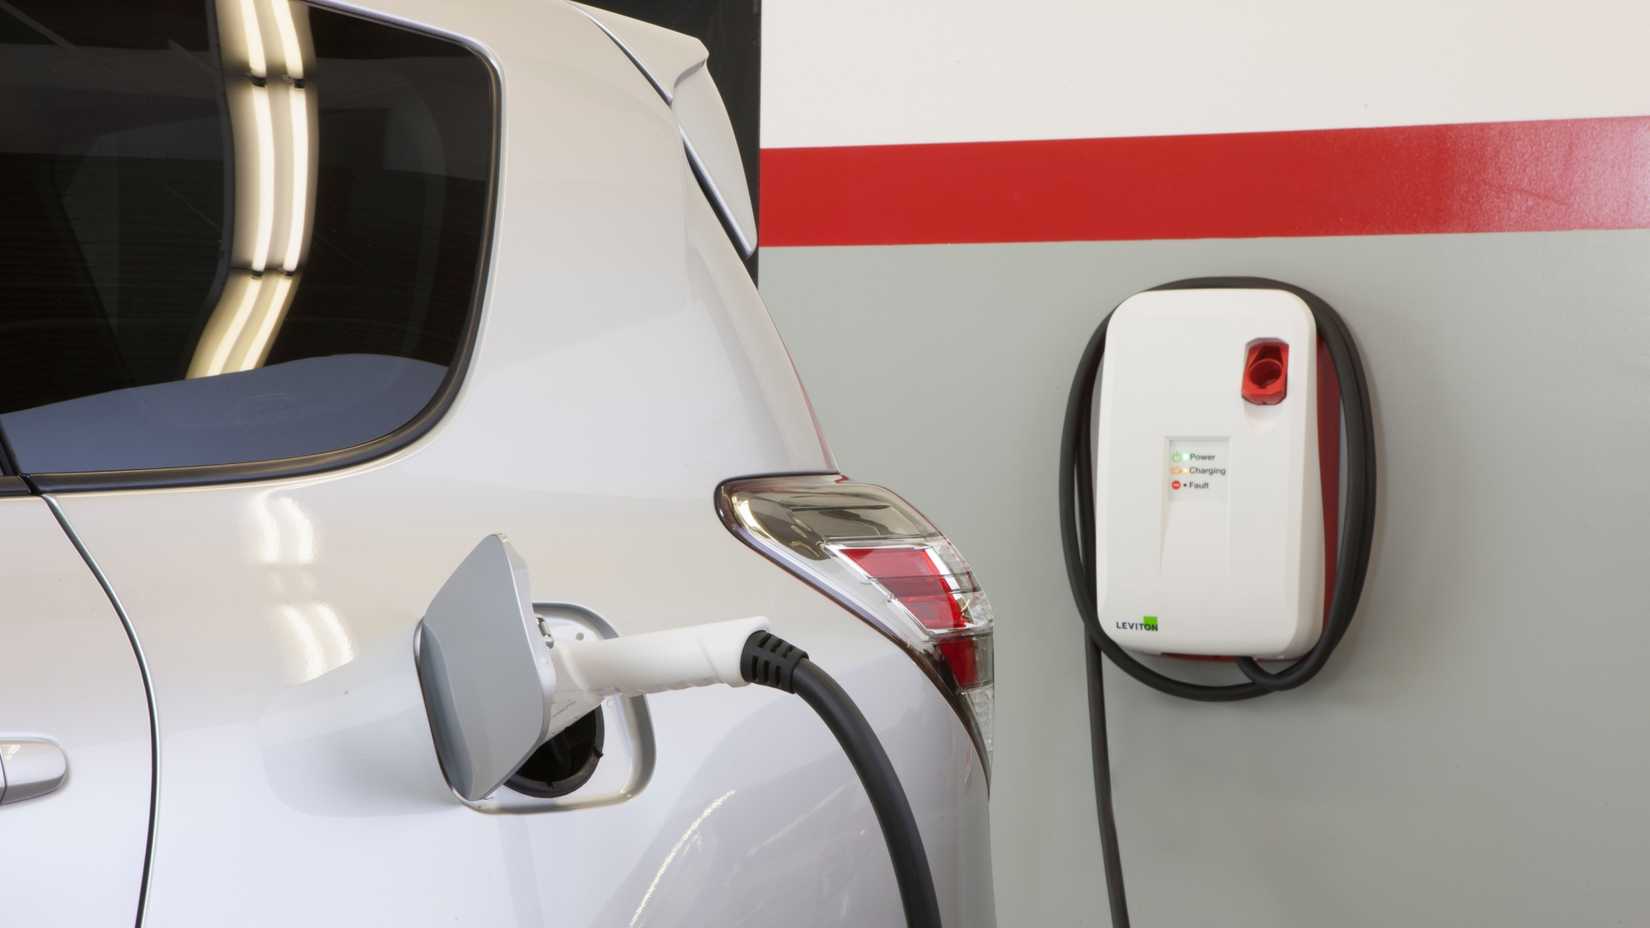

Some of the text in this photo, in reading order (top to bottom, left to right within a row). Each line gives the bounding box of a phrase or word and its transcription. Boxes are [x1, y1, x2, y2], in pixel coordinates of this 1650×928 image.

[1190, 453, 1216, 461] Power
[1189, 467, 1226, 476] Charging
[1189, 481, 1209, 489] Fault
[1116, 621, 1158, 631] LEVITON
